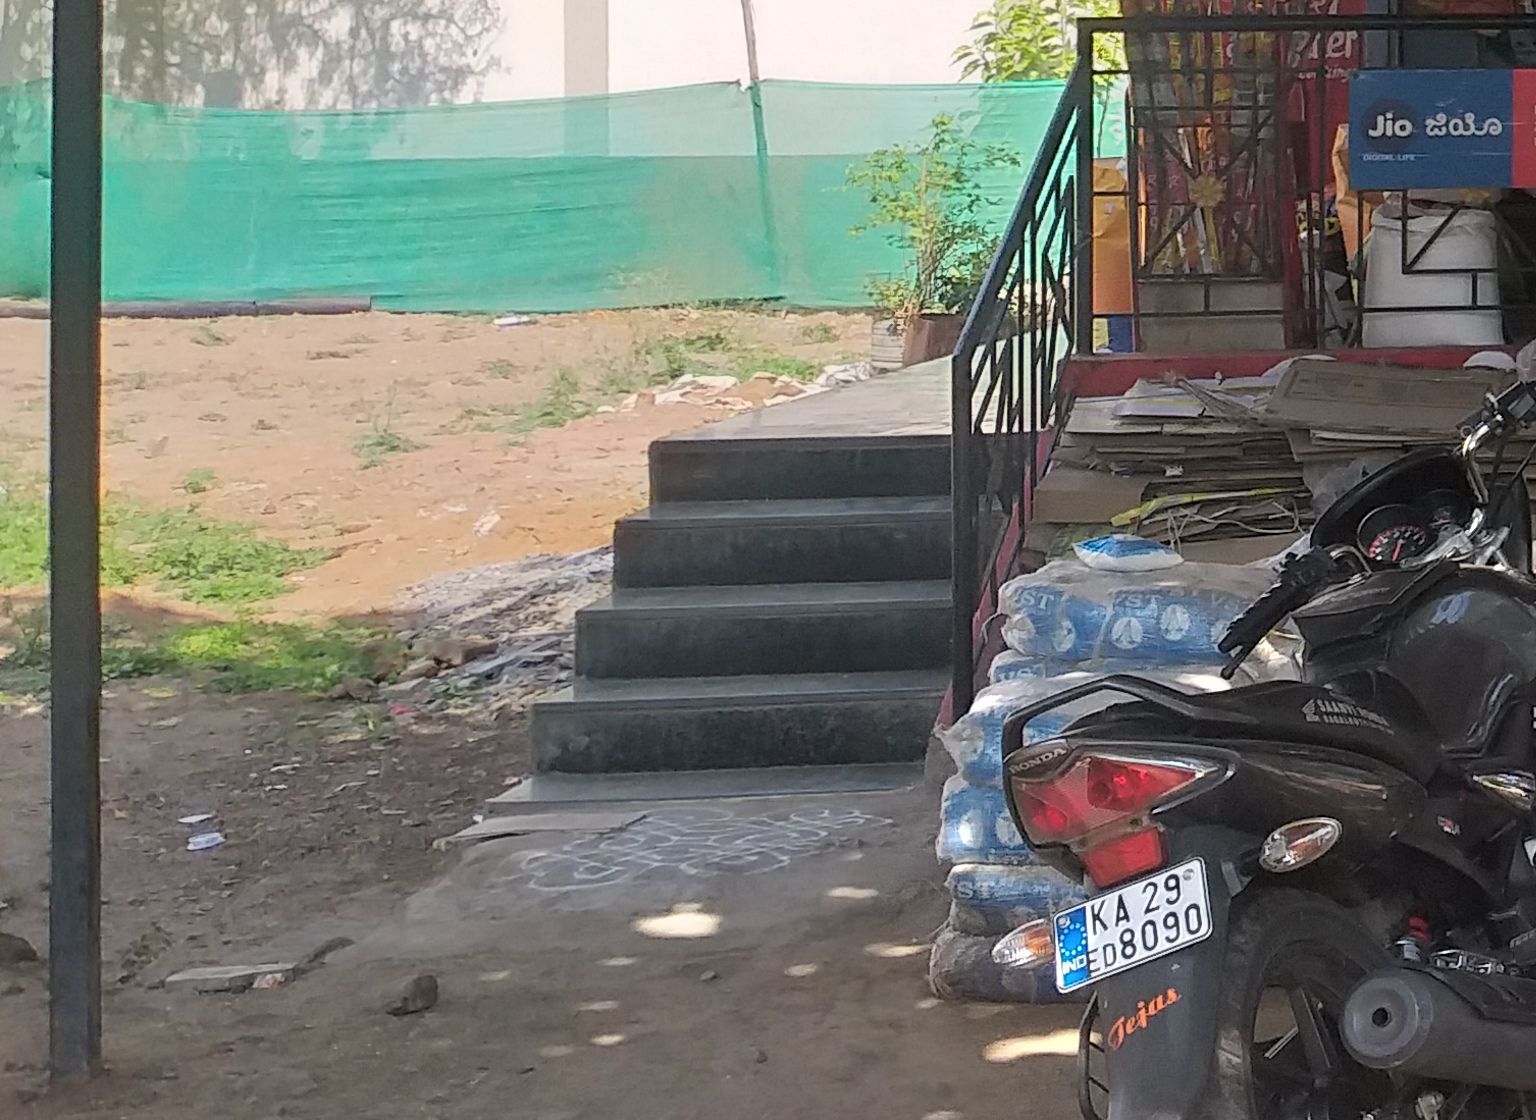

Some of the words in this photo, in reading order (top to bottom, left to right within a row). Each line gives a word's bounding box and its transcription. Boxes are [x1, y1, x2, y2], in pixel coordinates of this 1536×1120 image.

[1368, 112, 1413, 137] Jio
[1091, 893, 1130, 936] KA
[1141, 873, 1182, 915] 29
[1107, 985, 1182, 1050] Tejas
